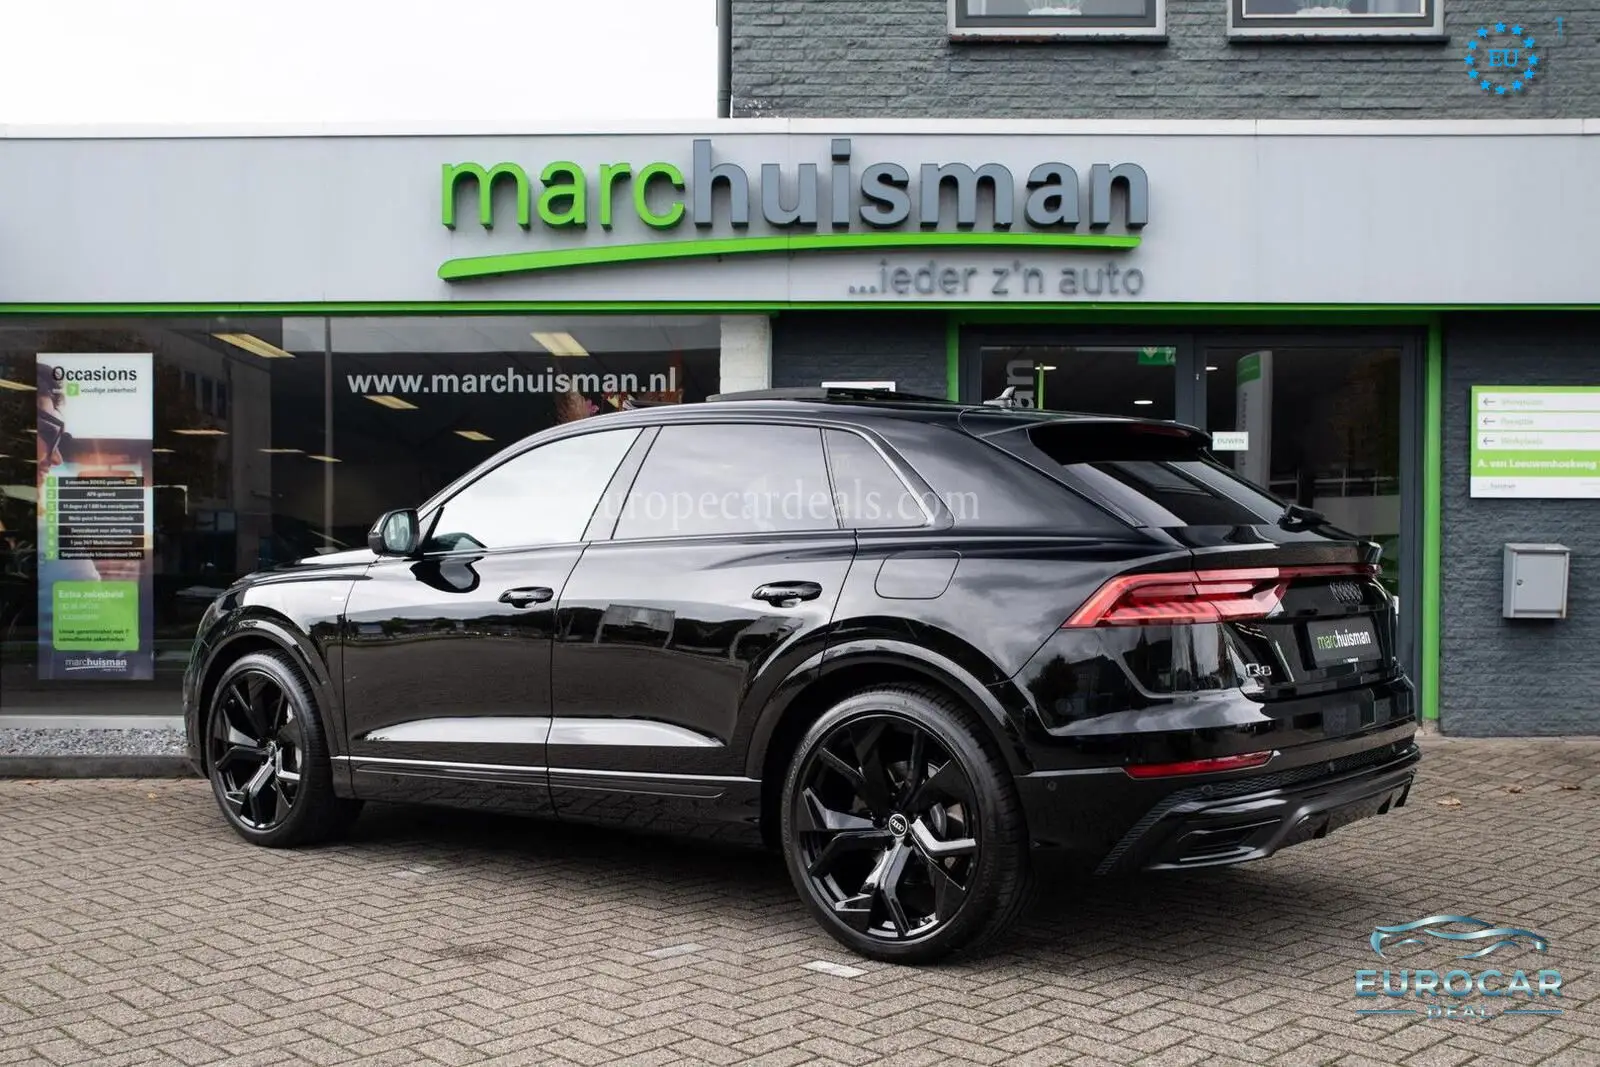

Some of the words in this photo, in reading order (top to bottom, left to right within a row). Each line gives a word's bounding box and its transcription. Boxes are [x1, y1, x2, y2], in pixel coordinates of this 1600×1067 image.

[441, 138, 1150, 232] marchuisman
[991, 259, 1045, 295] z'n
[1058, 260, 1145, 296] auto
[53, 366, 137, 381] Occasions
[347, 367, 677, 393] www.marchuisman.nl
[1317, 628, 1372, 650] marchuisman
[65, 657, 128, 667] marchuisman
[1246, 663, 1272, 677] Q8
